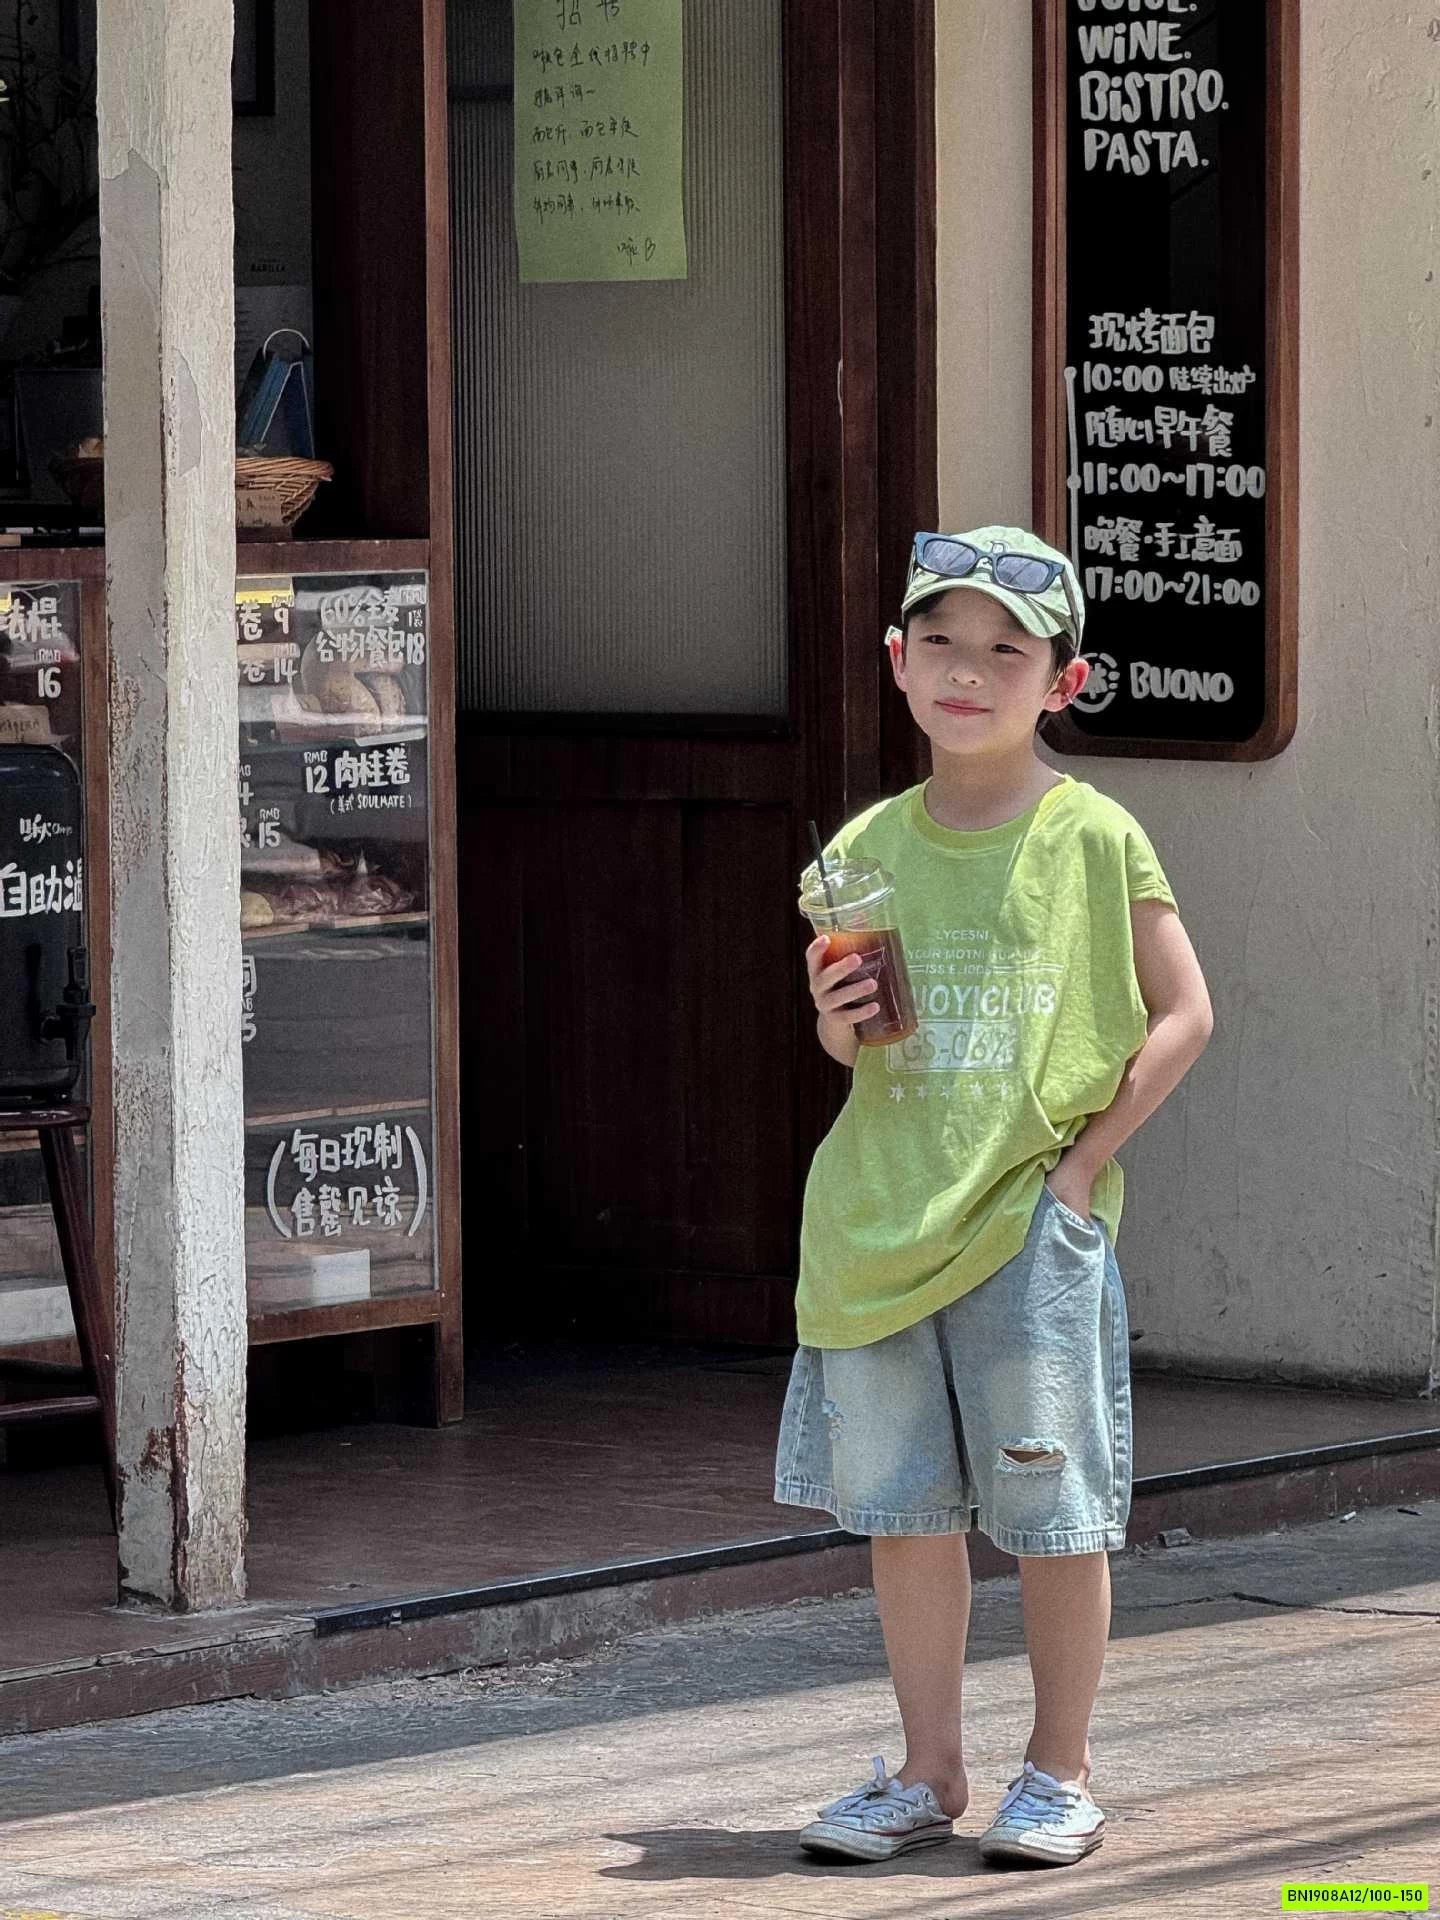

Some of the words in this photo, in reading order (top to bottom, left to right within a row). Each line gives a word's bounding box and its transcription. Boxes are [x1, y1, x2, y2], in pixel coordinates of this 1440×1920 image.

[1084, 128, 1209, 175] PASTA.
[1088, 308, 1215, 354] 现烤面包
[1083, 361, 1164, 393] 10:00
[1085, 404, 1234, 457] 随心早午餐
[1083, 461, 1265, 499] 11:00~17:00
[1085, 566, 1260, 606] 17:00~21:00
[274, 607, 289, 634] 9
[407, 632, 425, 665] 18
[38, 667, 61, 698] 16
[273, 657, 298, 683] 14
[1130, 661, 1234, 702] BUONO
[304, 750, 327, 763] RMB
[305, 764, 330, 793] 12
[334, 747, 410, 789] 肉桂卷
[259, 822, 280, 848] 15
